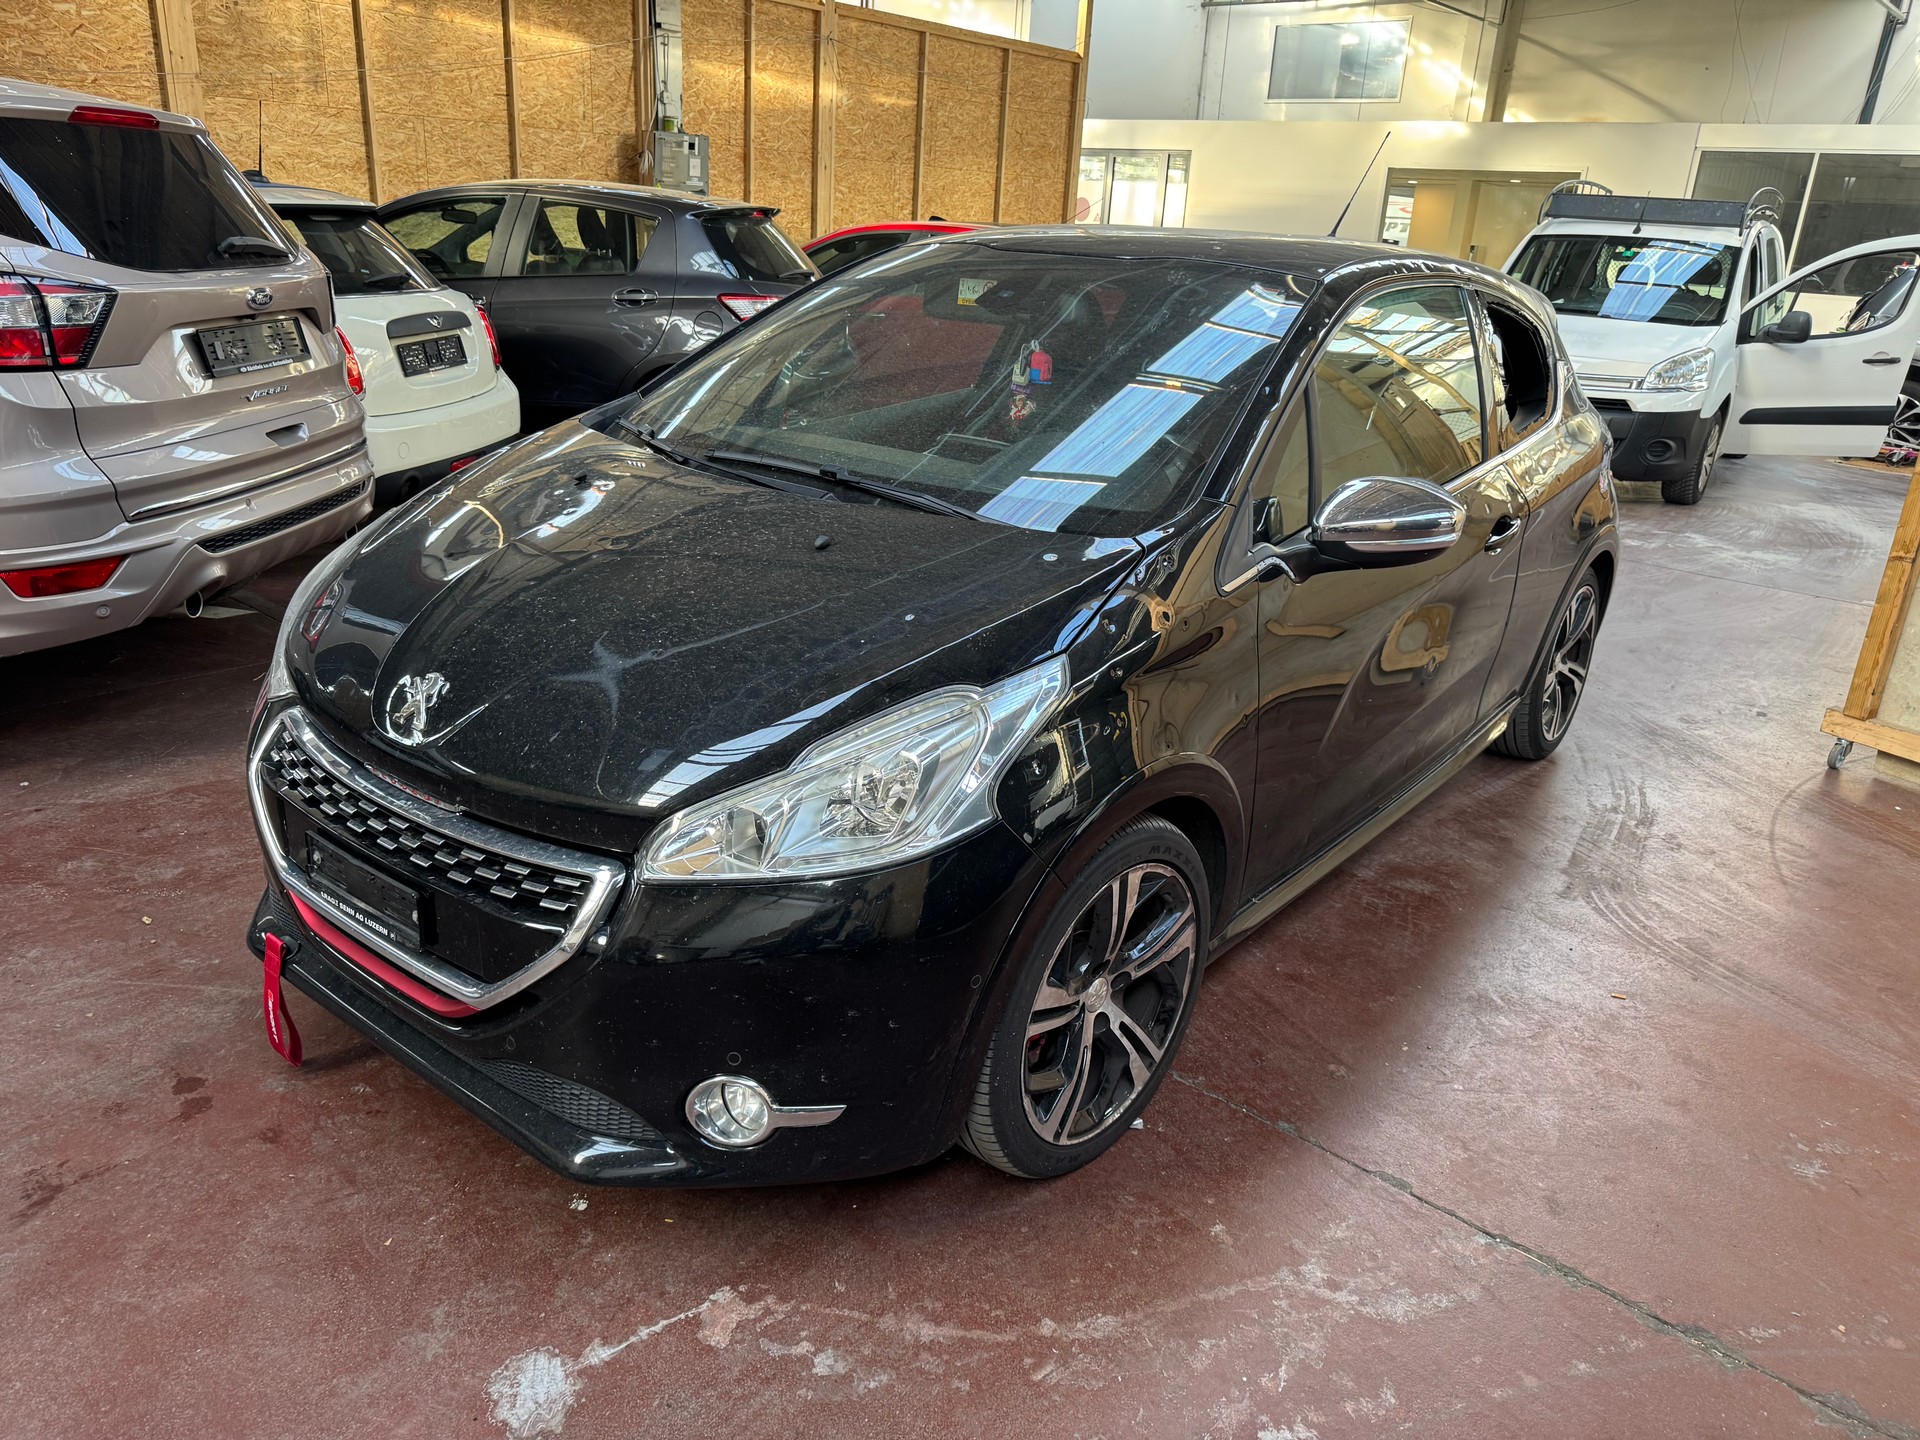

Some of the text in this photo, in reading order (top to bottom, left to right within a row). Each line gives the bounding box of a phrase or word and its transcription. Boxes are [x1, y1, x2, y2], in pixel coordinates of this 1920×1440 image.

[339, 902, 355, 917] SENN
[355, 912, 364, 922] AG
[364, 917, 388, 936] LUZERN
